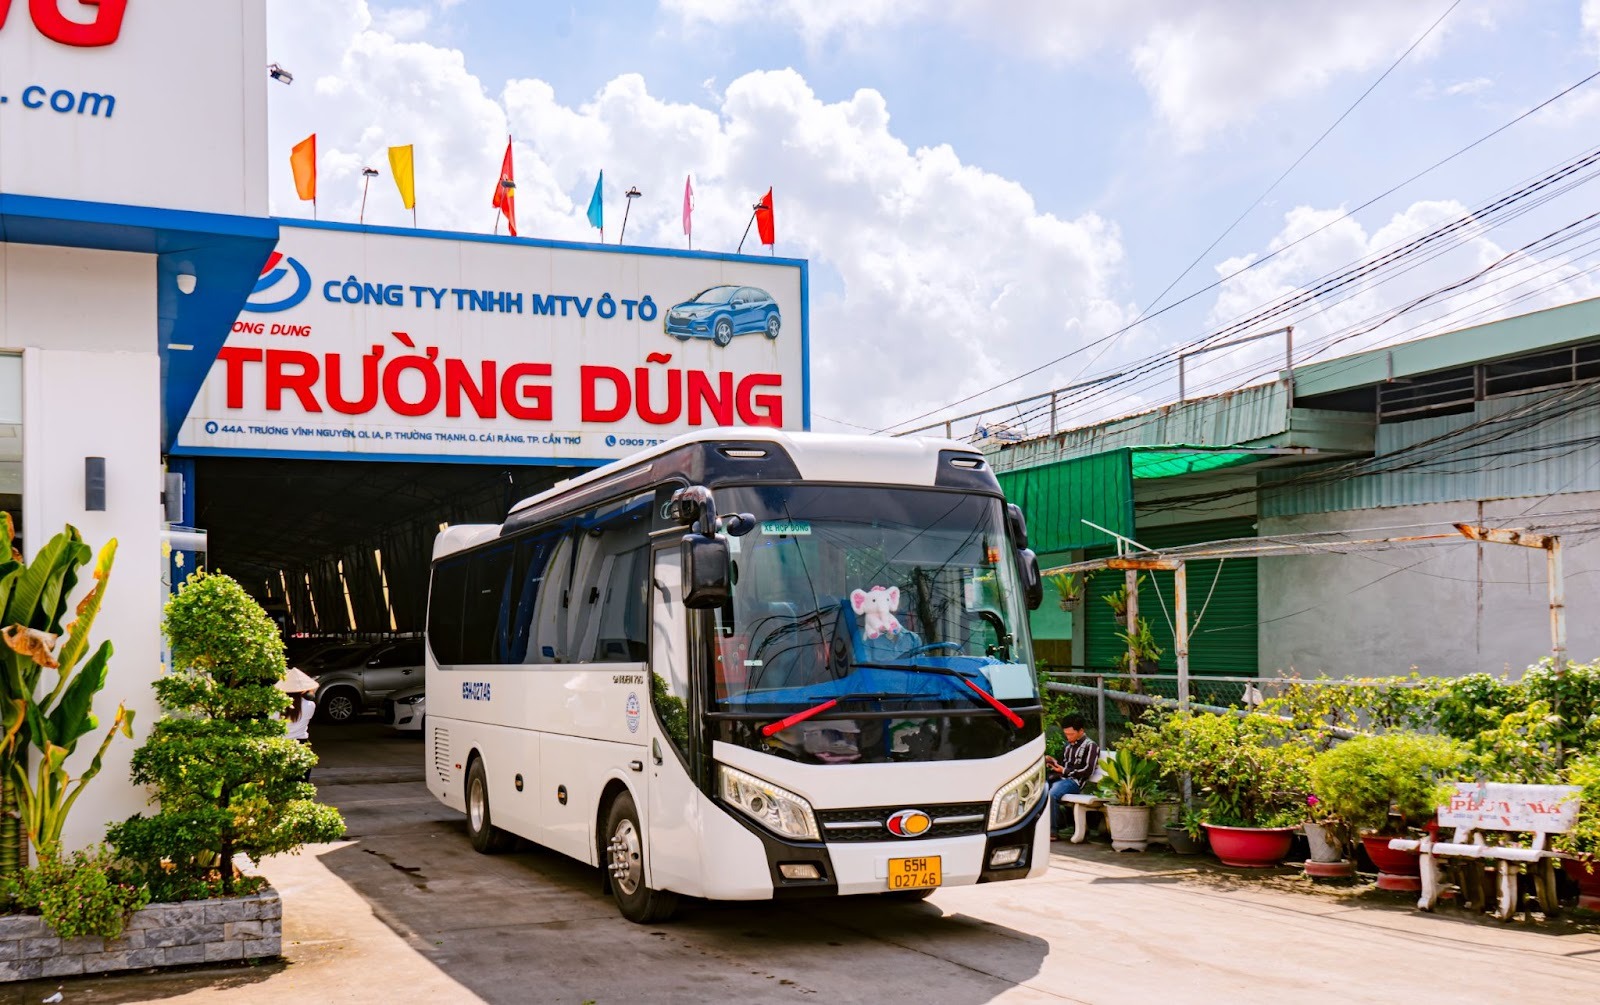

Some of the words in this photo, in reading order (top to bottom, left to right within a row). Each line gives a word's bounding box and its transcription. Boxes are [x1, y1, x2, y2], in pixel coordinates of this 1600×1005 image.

[323, 275, 403, 306] CÔNG
[410, 286, 447, 309] TY
[451, 288, 522, 313] TNHH
[533, 294, 592, 318] MTV
[597, 292, 616, 319] Ô
[621, 295, 657, 321] TÔ
[270, 323, 312, 337] DUNG
[217, 331, 552, 421] TRƯỜNG
[580, 352, 783, 428] DŨNG
[619, 438, 644, 446] 0909
[903, 859, 927, 872] 65H
[895, 872, 936, 888] 027.46
